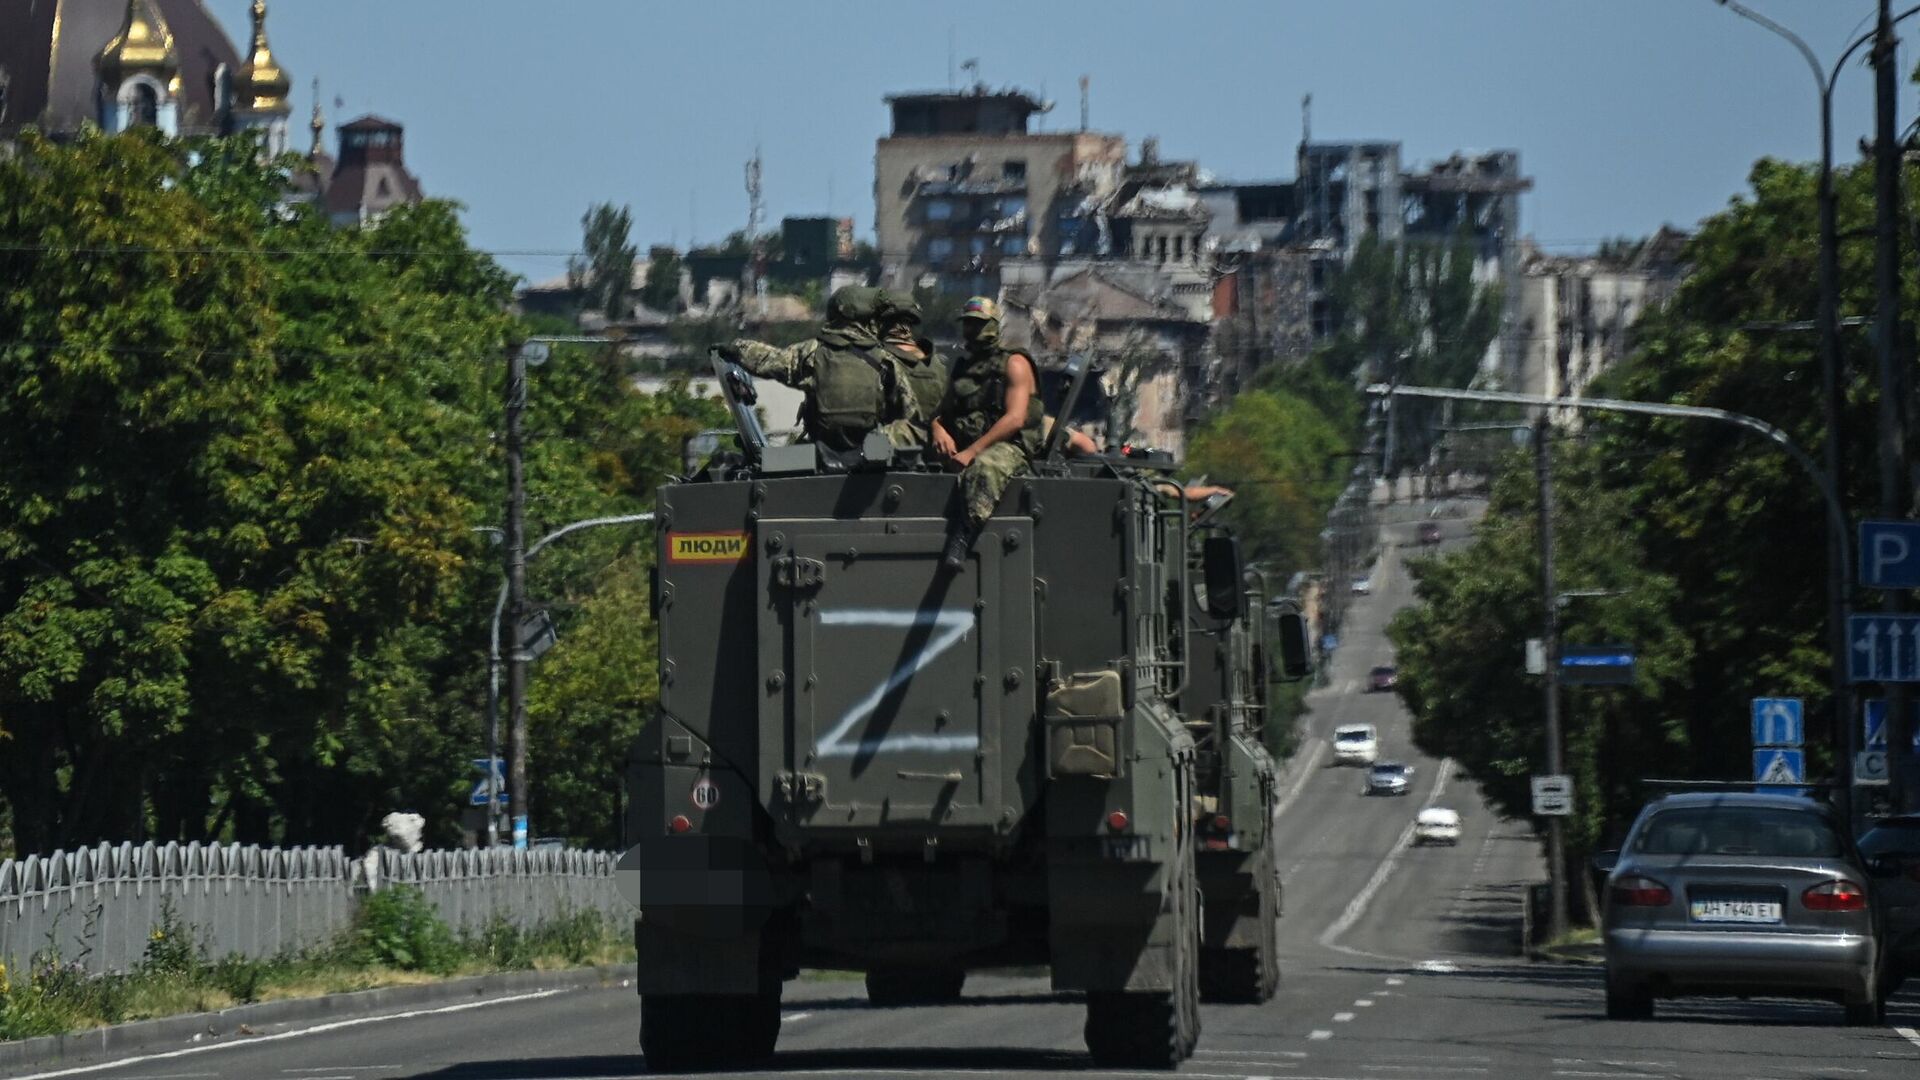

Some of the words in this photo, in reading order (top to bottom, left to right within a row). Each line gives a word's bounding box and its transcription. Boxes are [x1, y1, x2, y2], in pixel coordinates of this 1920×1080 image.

[678, 538, 742, 556] ЛЮДИ
[1872, 532, 1910, 583] P
[815, 608, 980, 758] Z
[696, 785, 717, 804] 60
